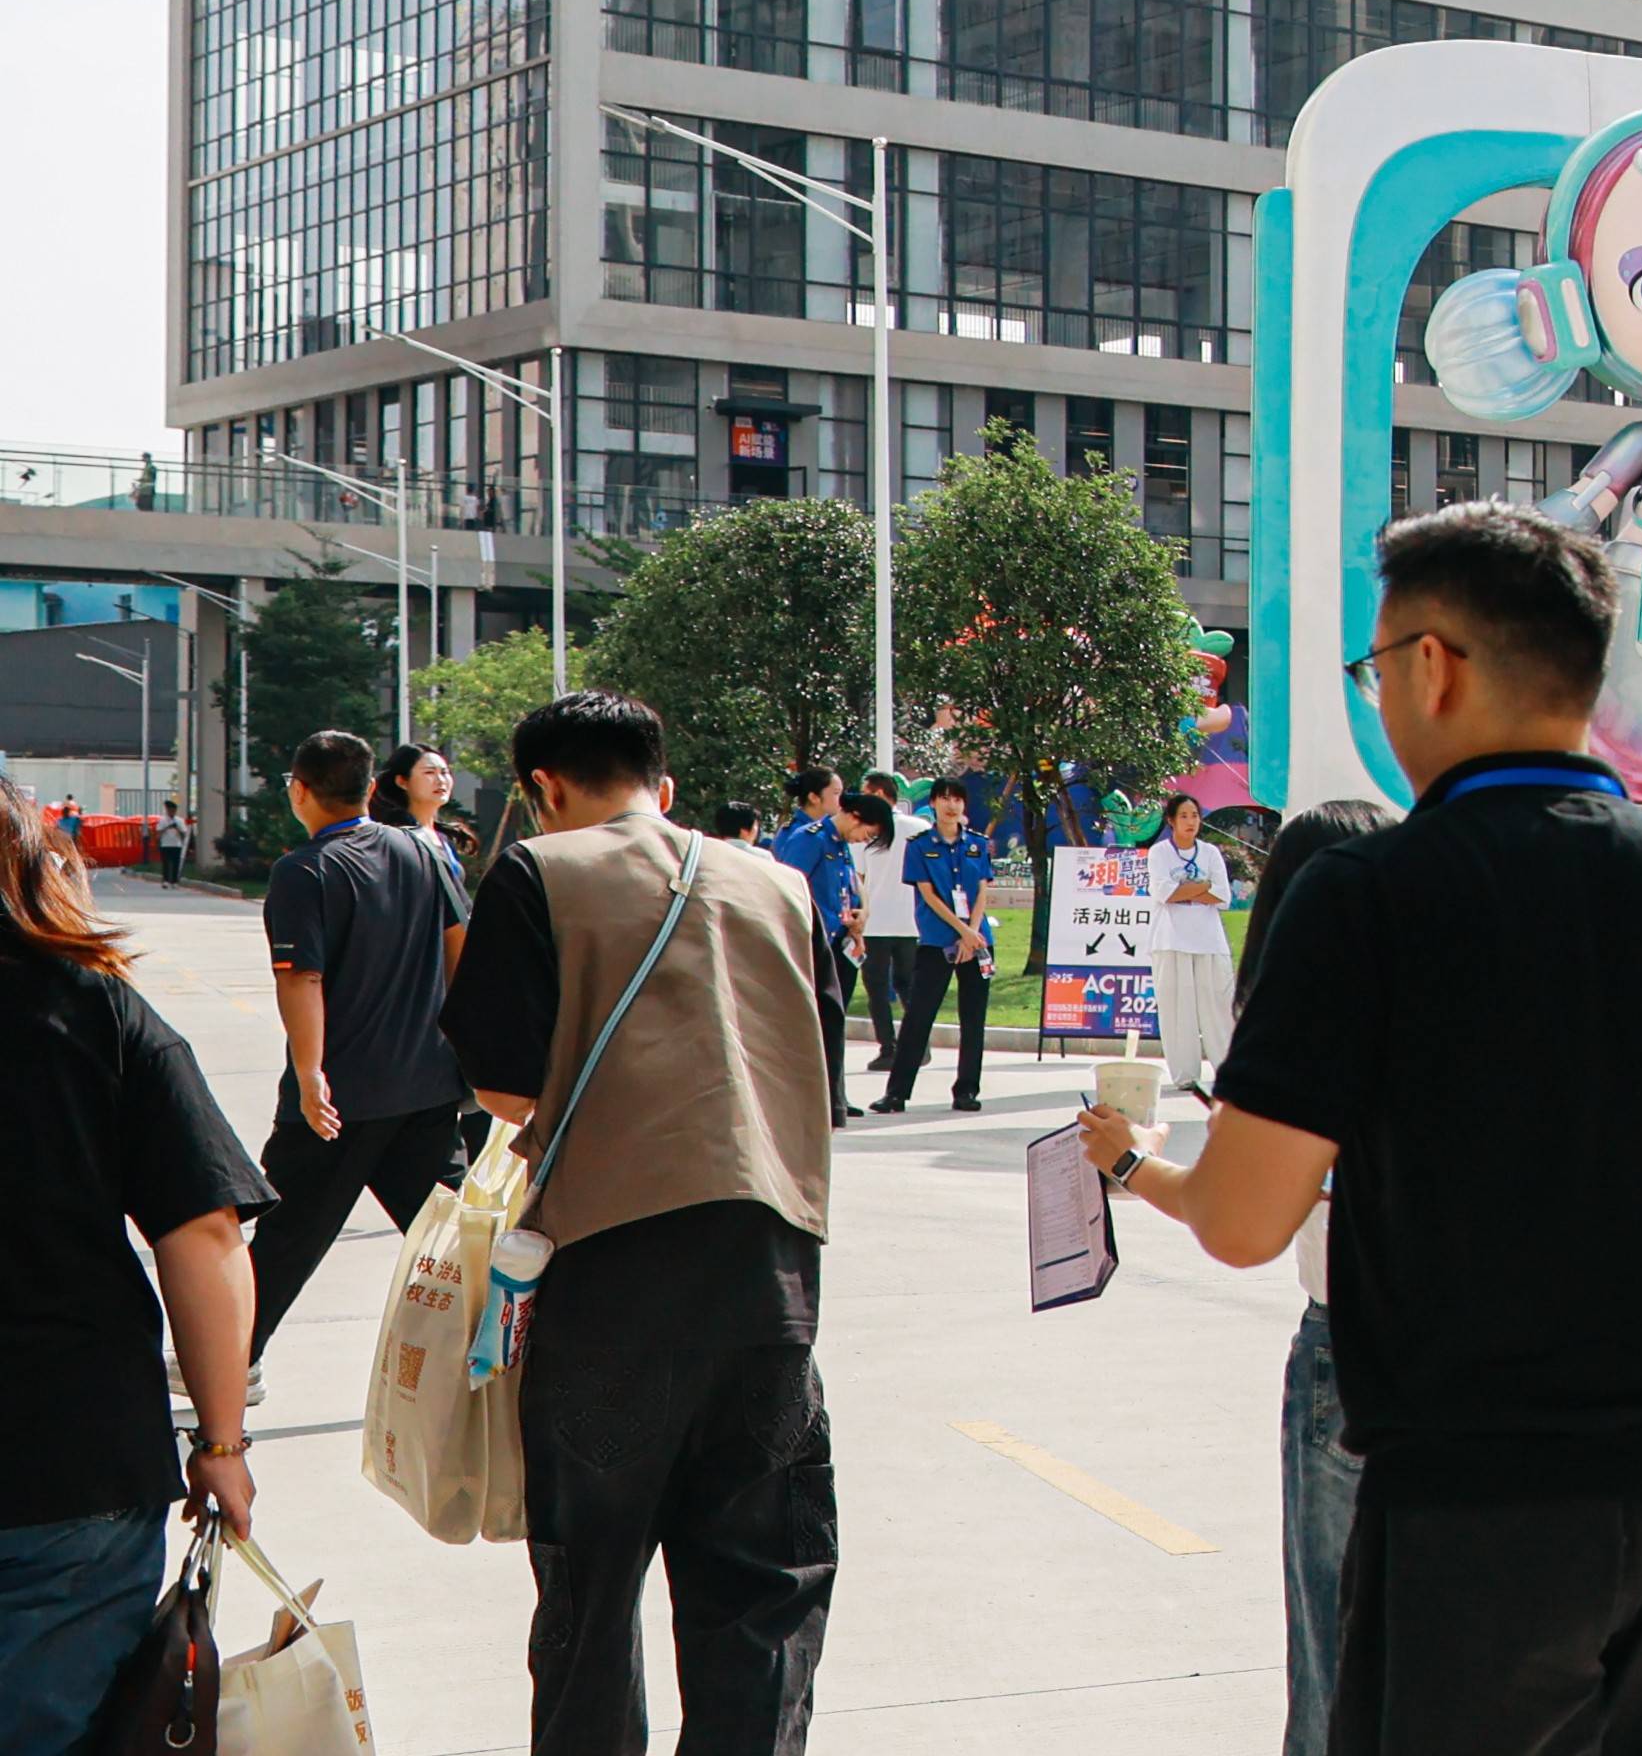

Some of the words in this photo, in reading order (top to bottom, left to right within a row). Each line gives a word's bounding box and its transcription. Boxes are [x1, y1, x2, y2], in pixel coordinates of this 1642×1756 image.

[1072, 907, 1150, 926] 活动出口
[1081, 974, 1154, 995] ACTIF
[1120, 996, 1157, 1013] 202
